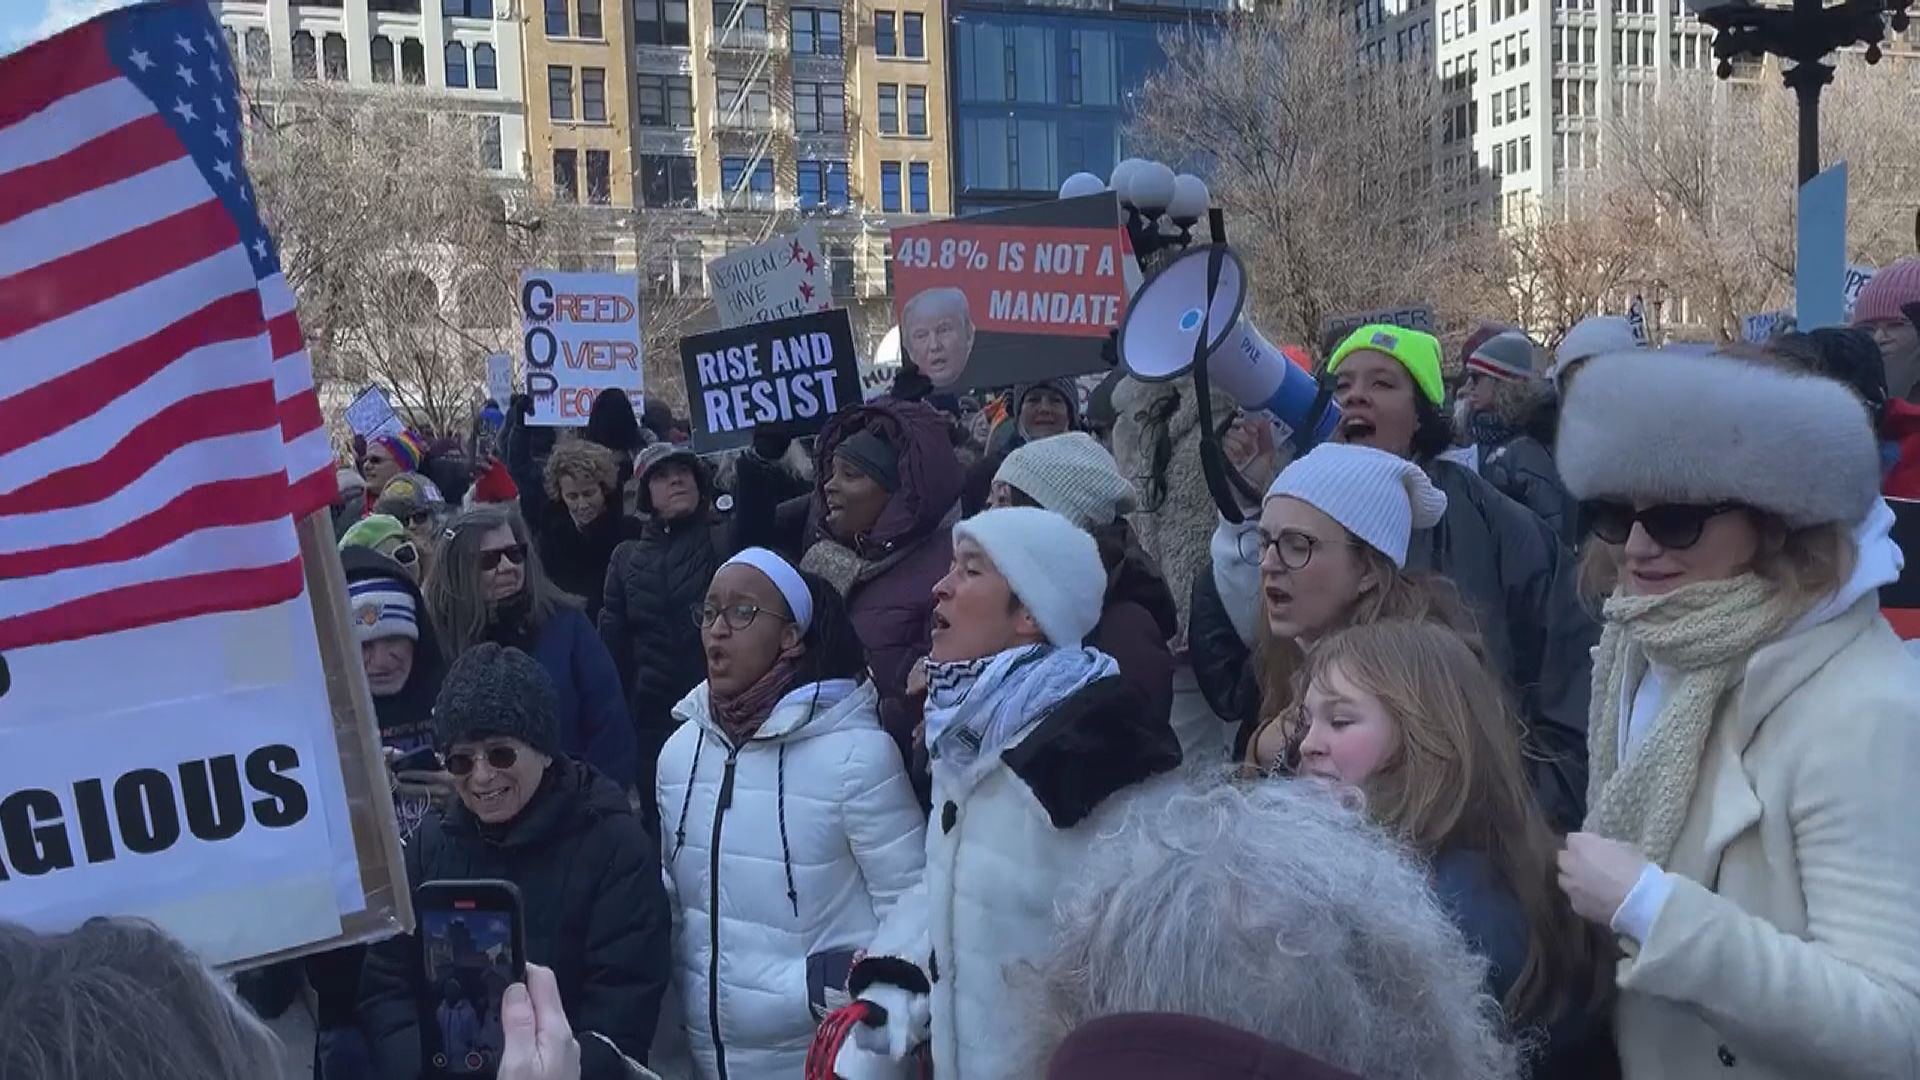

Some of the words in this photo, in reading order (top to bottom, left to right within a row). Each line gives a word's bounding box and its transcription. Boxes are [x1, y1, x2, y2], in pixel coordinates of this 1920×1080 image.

[896, 237, 988, 270] 49.8%
[998, 242, 1026, 272] IS
[1034, 243, 1089, 276] NOT
[1096, 245, 1115, 276] A
[522, 278, 635, 325] GREED
[728, 280, 767, 317] HAVE
[988, 289, 1121, 326] MANDATE
[525, 327, 639, 371] OVER
[695, 343, 763, 387] RISE
[771, 332, 834, 374] AND
[703, 369, 838, 434] RESIST
[0, 743, 308, 881] GIOUS
